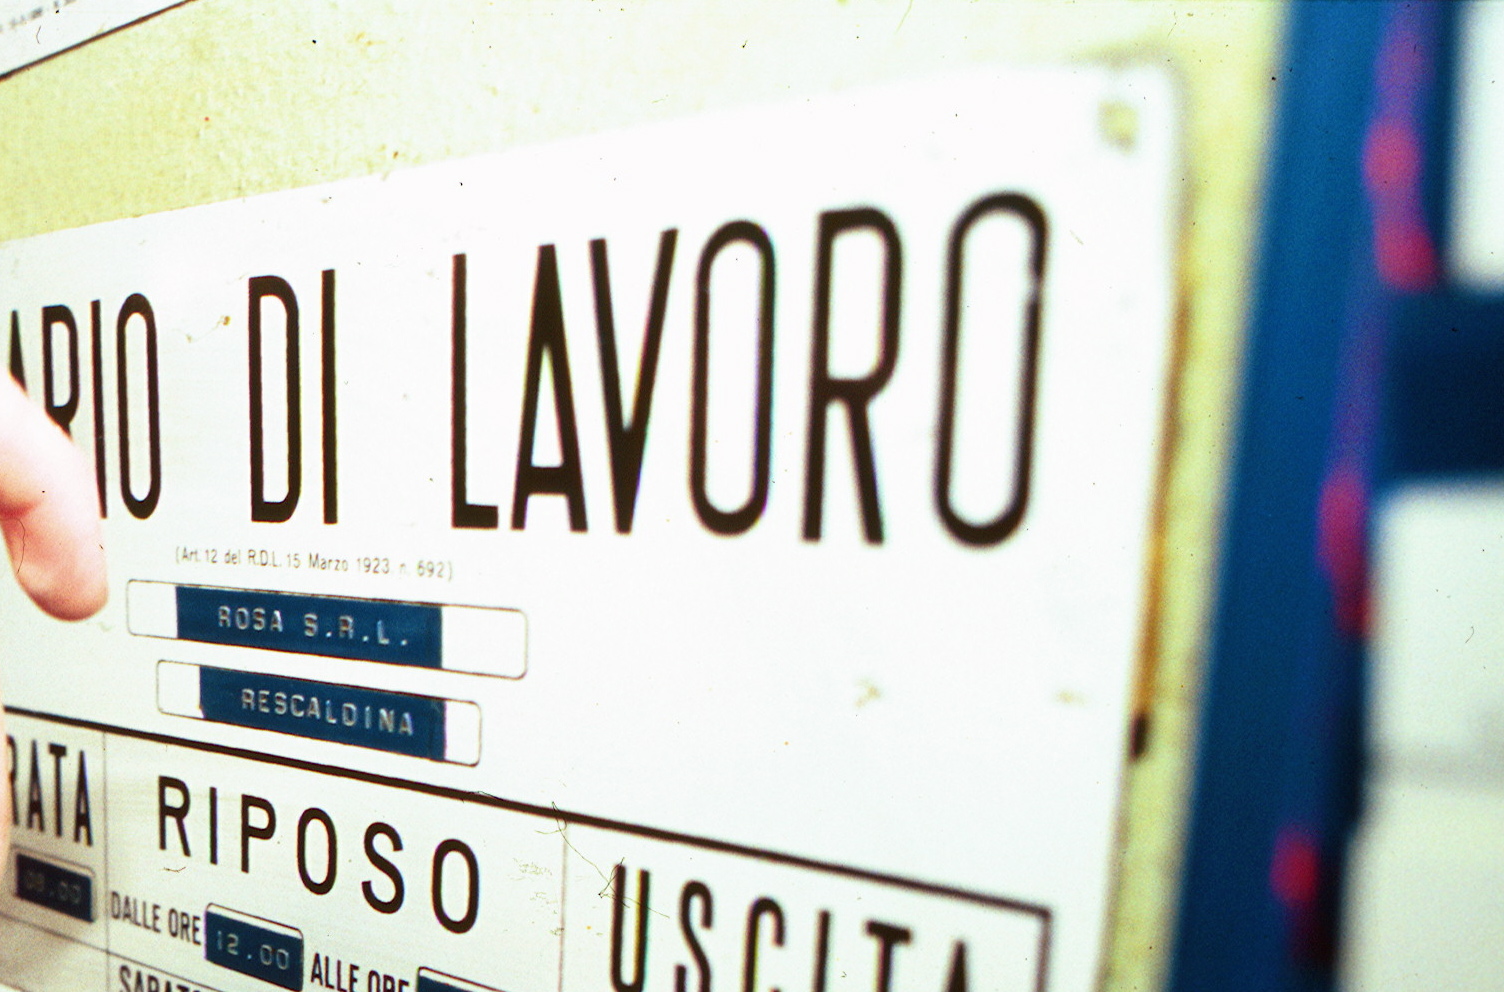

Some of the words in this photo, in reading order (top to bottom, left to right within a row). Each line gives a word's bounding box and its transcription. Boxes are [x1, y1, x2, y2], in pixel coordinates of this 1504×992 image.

[248, 268, 338, 525] DI
[451, 191, 1050, 546] LAVORO
[224, 549, 241, 566] del
[287, 553, 301, 569] 15
[308, 553, 348, 573] Marzo
[357, 556, 390, 575] 1923
[217, 605, 284, 633] ROSA
[304, 612, 408, 646] S.R.L.
[241, 687, 415, 737] RESCALDINA
[6, 734, 93, 847] RATA
[158, 774, 481, 934] RIPOSO
[110, 891, 162, 933] DALLE
[168, 908, 202, 946] ORE
[216, 930, 291, 972] 12.00
